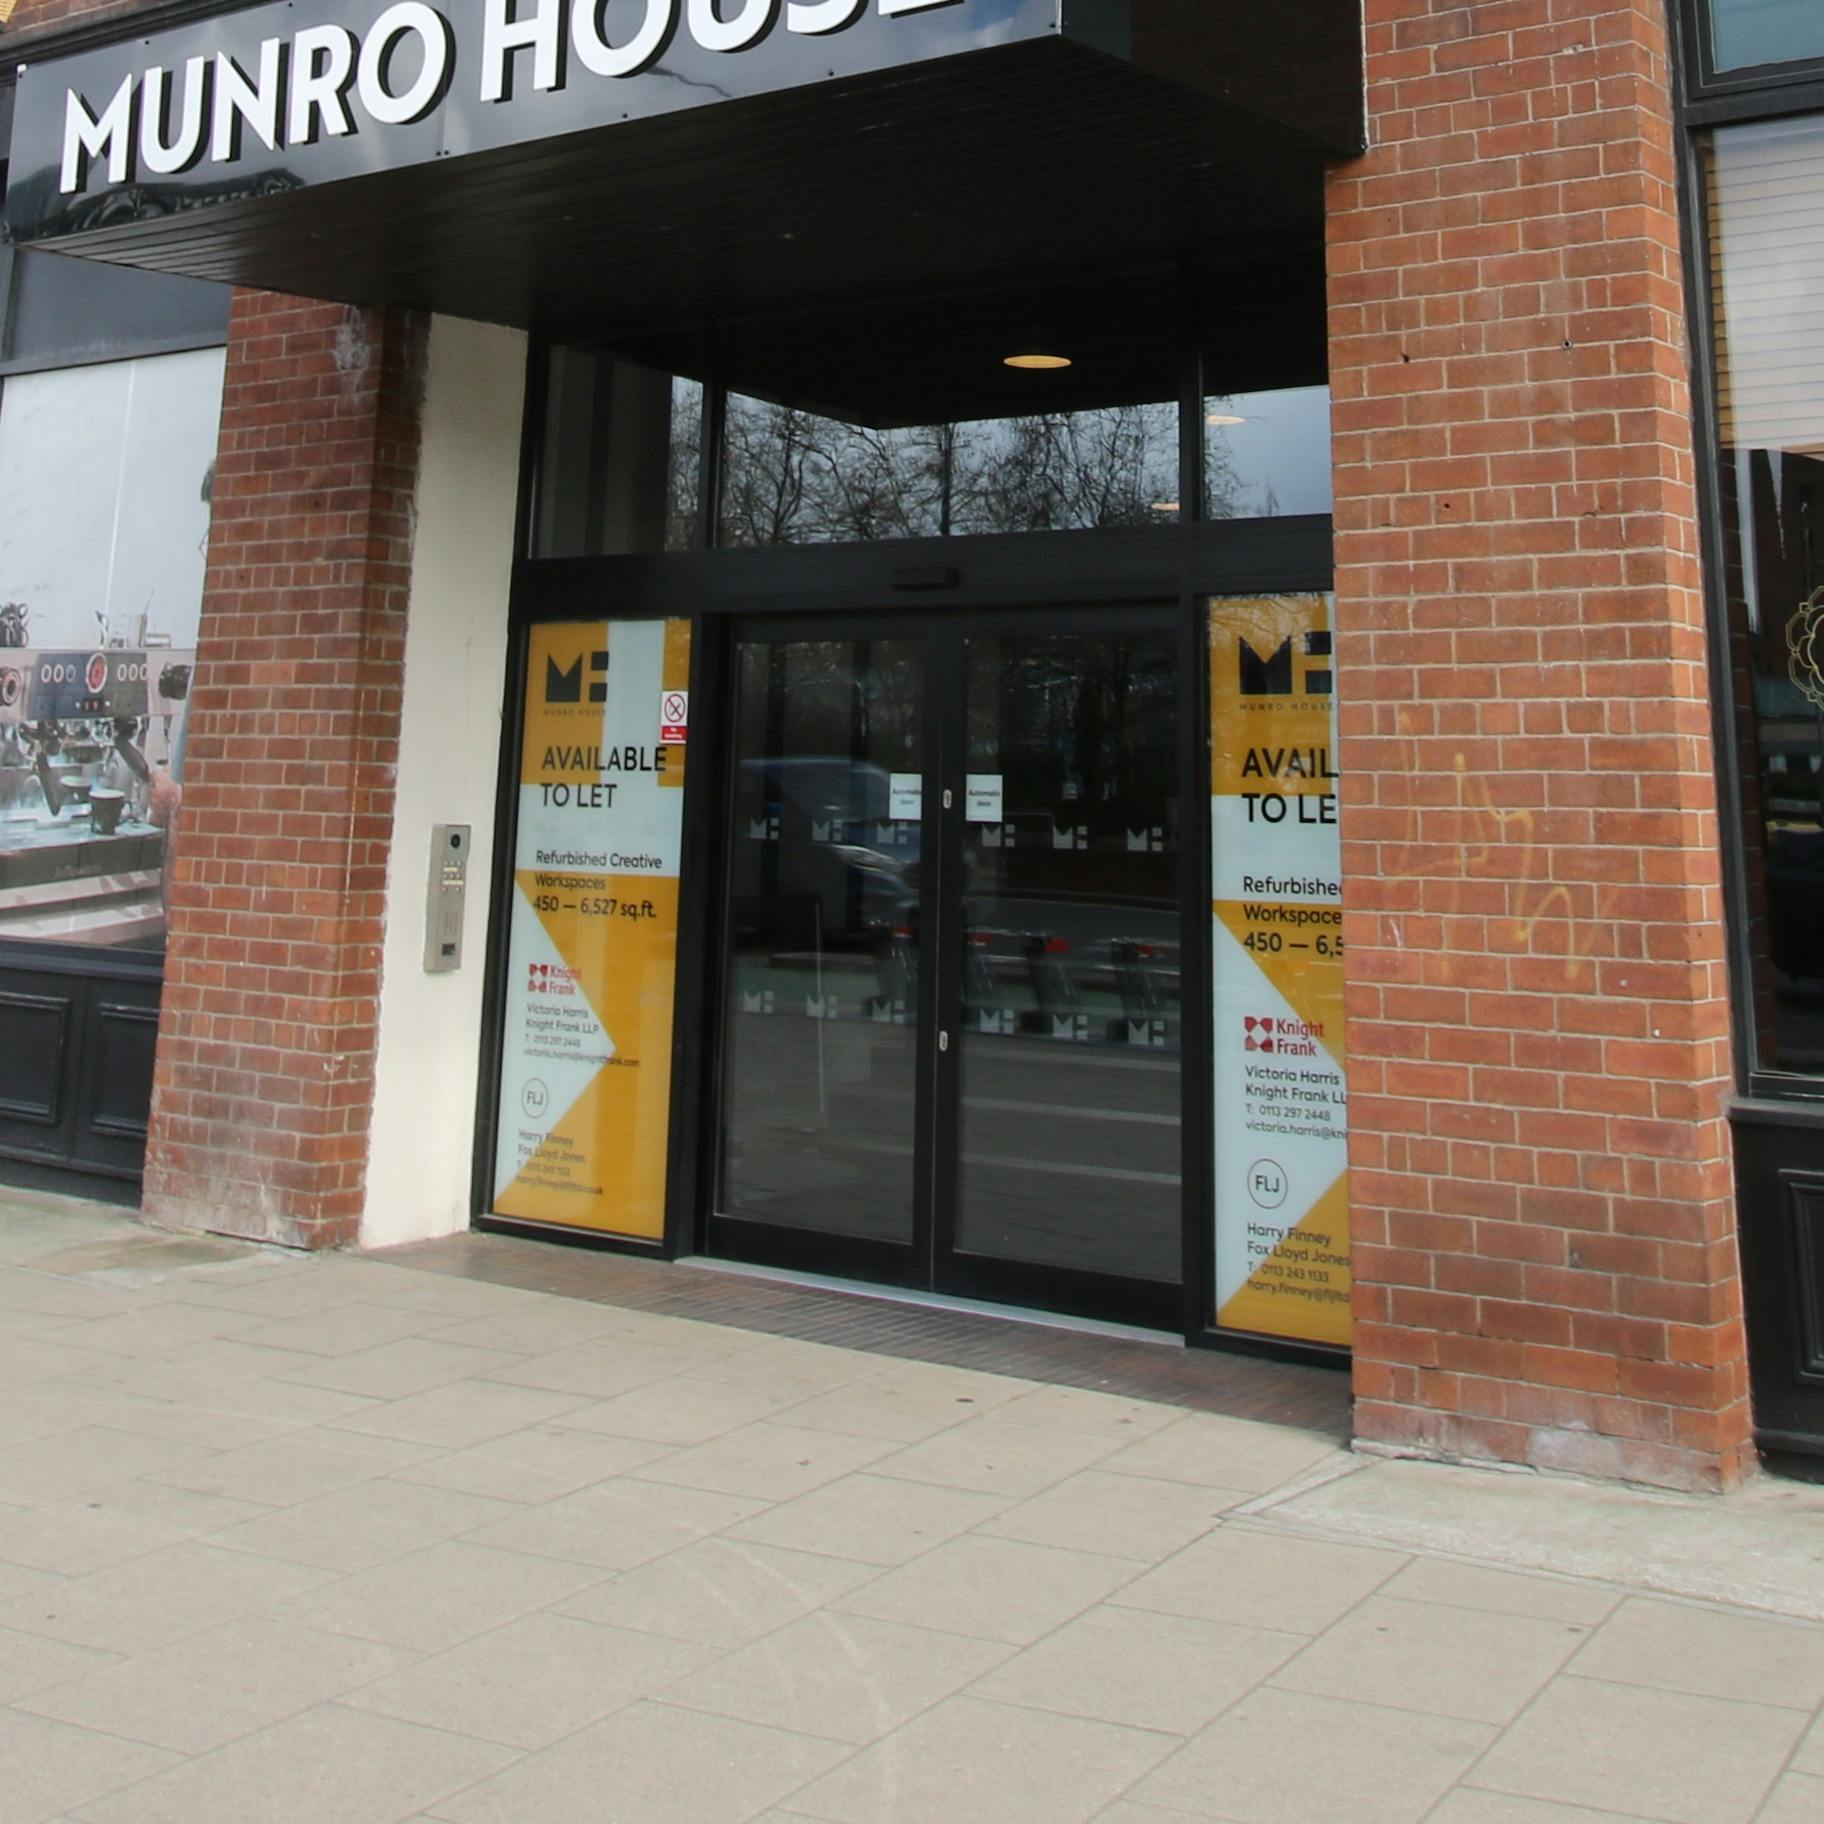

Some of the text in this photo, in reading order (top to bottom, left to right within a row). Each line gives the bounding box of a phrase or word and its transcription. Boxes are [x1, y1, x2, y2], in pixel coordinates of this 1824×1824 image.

[59, 0, 452, 195] MUNRO
[1239, 703, 1334, 711] MUNRO HOUSE
[541, 745, 667, 772] AVAILABLE
[1241, 748, 1340, 778] AVAIL
[540, 783, 618, 808] TO LET
[1241, 793, 1337, 824] TO LE
[536, 850, 662, 869] Refurbished Creative
[534, 872, 606, 891] Workspaces
[1243, 875, 1342, 896] Refurbishe
[534, 895, 559, 912] 450
[580, 897, 618, 916] 6,527
[620, 900, 657, 921] sq.ft.
[1244, 932, 1283, 953] 450
[550, 964, 582, 982] Knight
[549, 980, 576, 996] Frank
[526, 1003, 589, 1018] Victoria Harris
[526, 1018, 600, 1034] Knight Frank LLP
[1276, 1018, 1326, 1041] Knight
[1276, 1038, 1318, 1057] Frank
[1245, 1065, 1340, 1086] Victoria Harris
[527, 1090, 544, 1106] FLJ
[1245, 1083, 1289, 1102] Knight
[1291, 1087, 1329, 1104] Frank
[1245, 1102, 1331, 1122] T: 0113 297 2448
[518, 1128, 574, 1148] Harry Finney
[517, 1143, 586, 1164] Fox Lloyd Jones
[1255, 1175, 1280, 1193] FLJ
[1247, 1223, 1331, 1248] Harry Finney
[1247, 1240, 1270, 1256] Fox
[1273, 1244, 1309, 1263] Lloyd
[1261, 1263, 1284, 1276] 0113
[1286, 1266, 1305, 1280] 243
[1308, 1270, 1329, 1283] 1133
